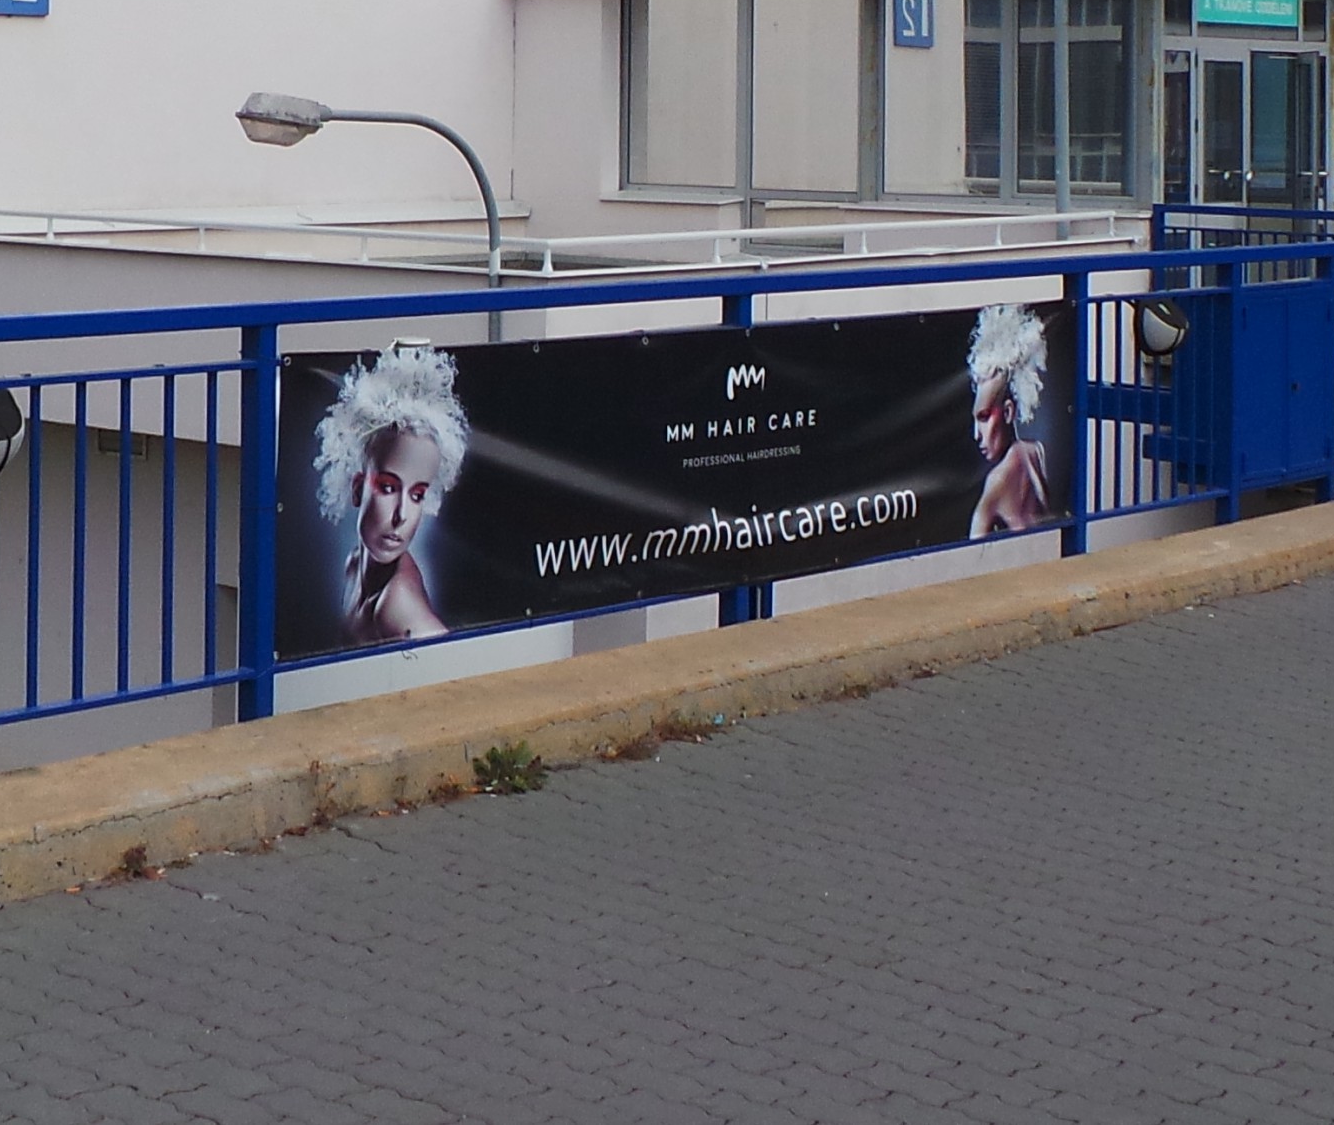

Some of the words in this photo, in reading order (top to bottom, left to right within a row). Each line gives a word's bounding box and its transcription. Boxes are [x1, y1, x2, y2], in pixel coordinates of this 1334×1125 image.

[667, 423, 695, 443] MM
[707, 416, 757, 439] HAIR
[768, 409, 817, 431] CARE
[683, 453, 745, 469] PROFESSIONAL
[747, 445, 801, 461] HAIRDRESSING
[535, 488, 919, 578] www.mmhaircare.com
